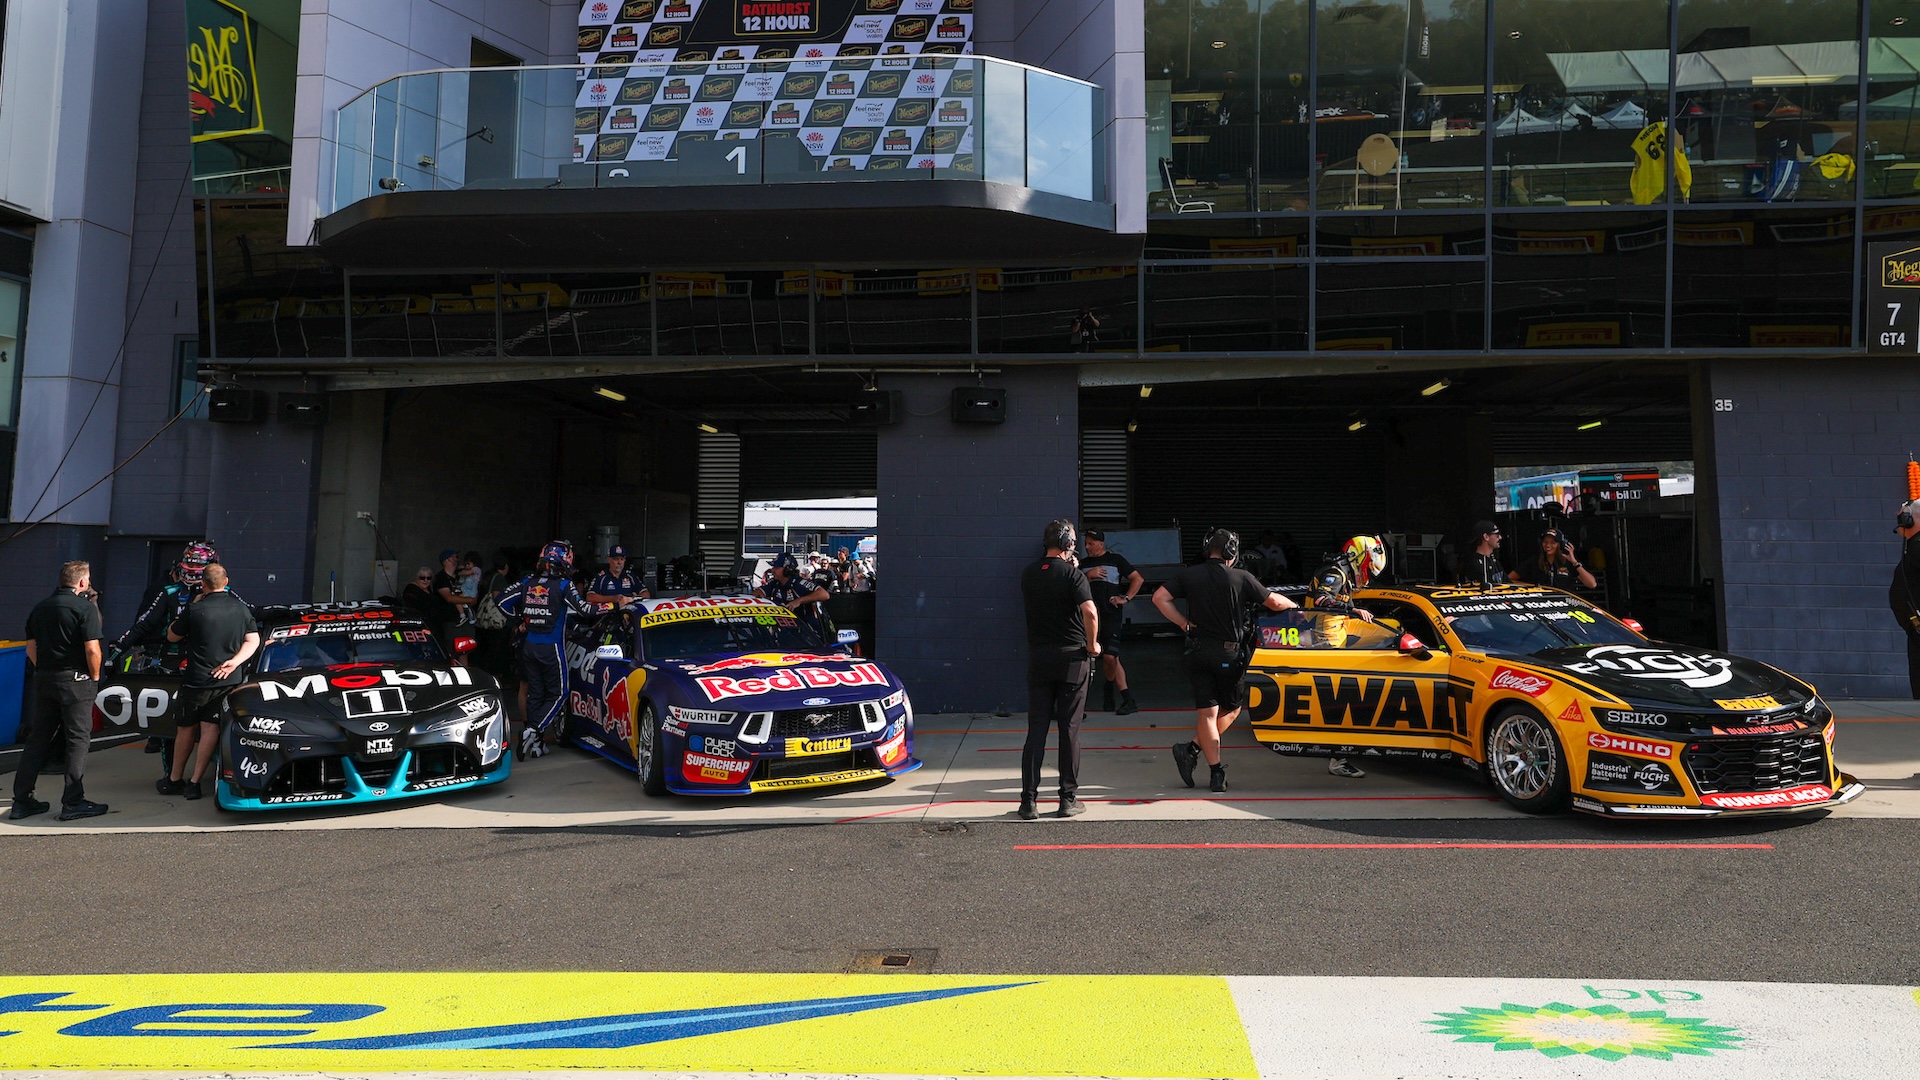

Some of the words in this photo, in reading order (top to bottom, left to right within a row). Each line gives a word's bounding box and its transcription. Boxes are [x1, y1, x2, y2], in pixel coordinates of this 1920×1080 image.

[742, 3, 811, 16] BATHURST
[742, 16, 762, 31] 12
[764, 15, 811, 31] HOUR
[637, 139, 649, 147] feel
[725, 146, 746, 174] 1
[1887, 303, 1901, 326] 7
[1880, 332, 1906, 346] GT4
[1714, 399, 1734, 412] 35
[1600, 489, 1630, 501] Mobil
[653, 598, 774, 612] AMPOL
[1440, 601, 1511, 613] Industrial
[301, 610, 394, 622] Coates
[643, 609, 722, 627] NATIONAL
[722, 604, 789, 618] STORAGE
[756, 615, 777, 626] 88
[1568, 610, 1595, 623] 18
[1433, 616, 1450, 635] RYCO
[272, 627, 311, 639] GR
[391, 630, 404, 643] 1
[1276, 627, 1300, 646] 18
[124, 655, 134, 673] 1
[257, 666, 474, 702] Mobil
[694, 668, 808, 705] Red
[796, 662, 891, 689] Bull
[95, 685, 179, 728] OP
[361, 690, 385, 713] 1
[458, 697, 490, 716] NGK
[571, 690, 588, 718] Red
[682, 711, 718, 722] WÜRTH
[1561, 703, 1583, 721] Sika
[1607, 710, 1668, 727] SEIKO
[248, 717, 286, 732] NGK
[1727, 725, 1771, 736] BUILDING
[1770, 723, 1798, 734] TRUST
[367, 737, 394, 751] NTK
[705, 737, 736, 750] QUAD
[800, 736, 852, 754] Century
[1272, 743, 1304, 755] Dealify
[1611, 738, 1672, 757] HINO
[704, 745, 735, 759] LOCK
[1421, 748, 1441, 759] ive
[685, 753, 750, 773] SUPERCHEAP
[1591, 761, 1630, 774] Industrial
[703, 769, 727, 779] AUTO
[1591, 769, 1628, 781] Batteries
[1632, 771, 1671, 784] FUCHS
[412, 782, 428, 792] JB
[429, 775, 479, 789] Caravans
[285, 794, 344, 803] Caravans
[1710, 791, 1791, 808] HUNGRY
[1791, 787, 1829, 801] JACKS
